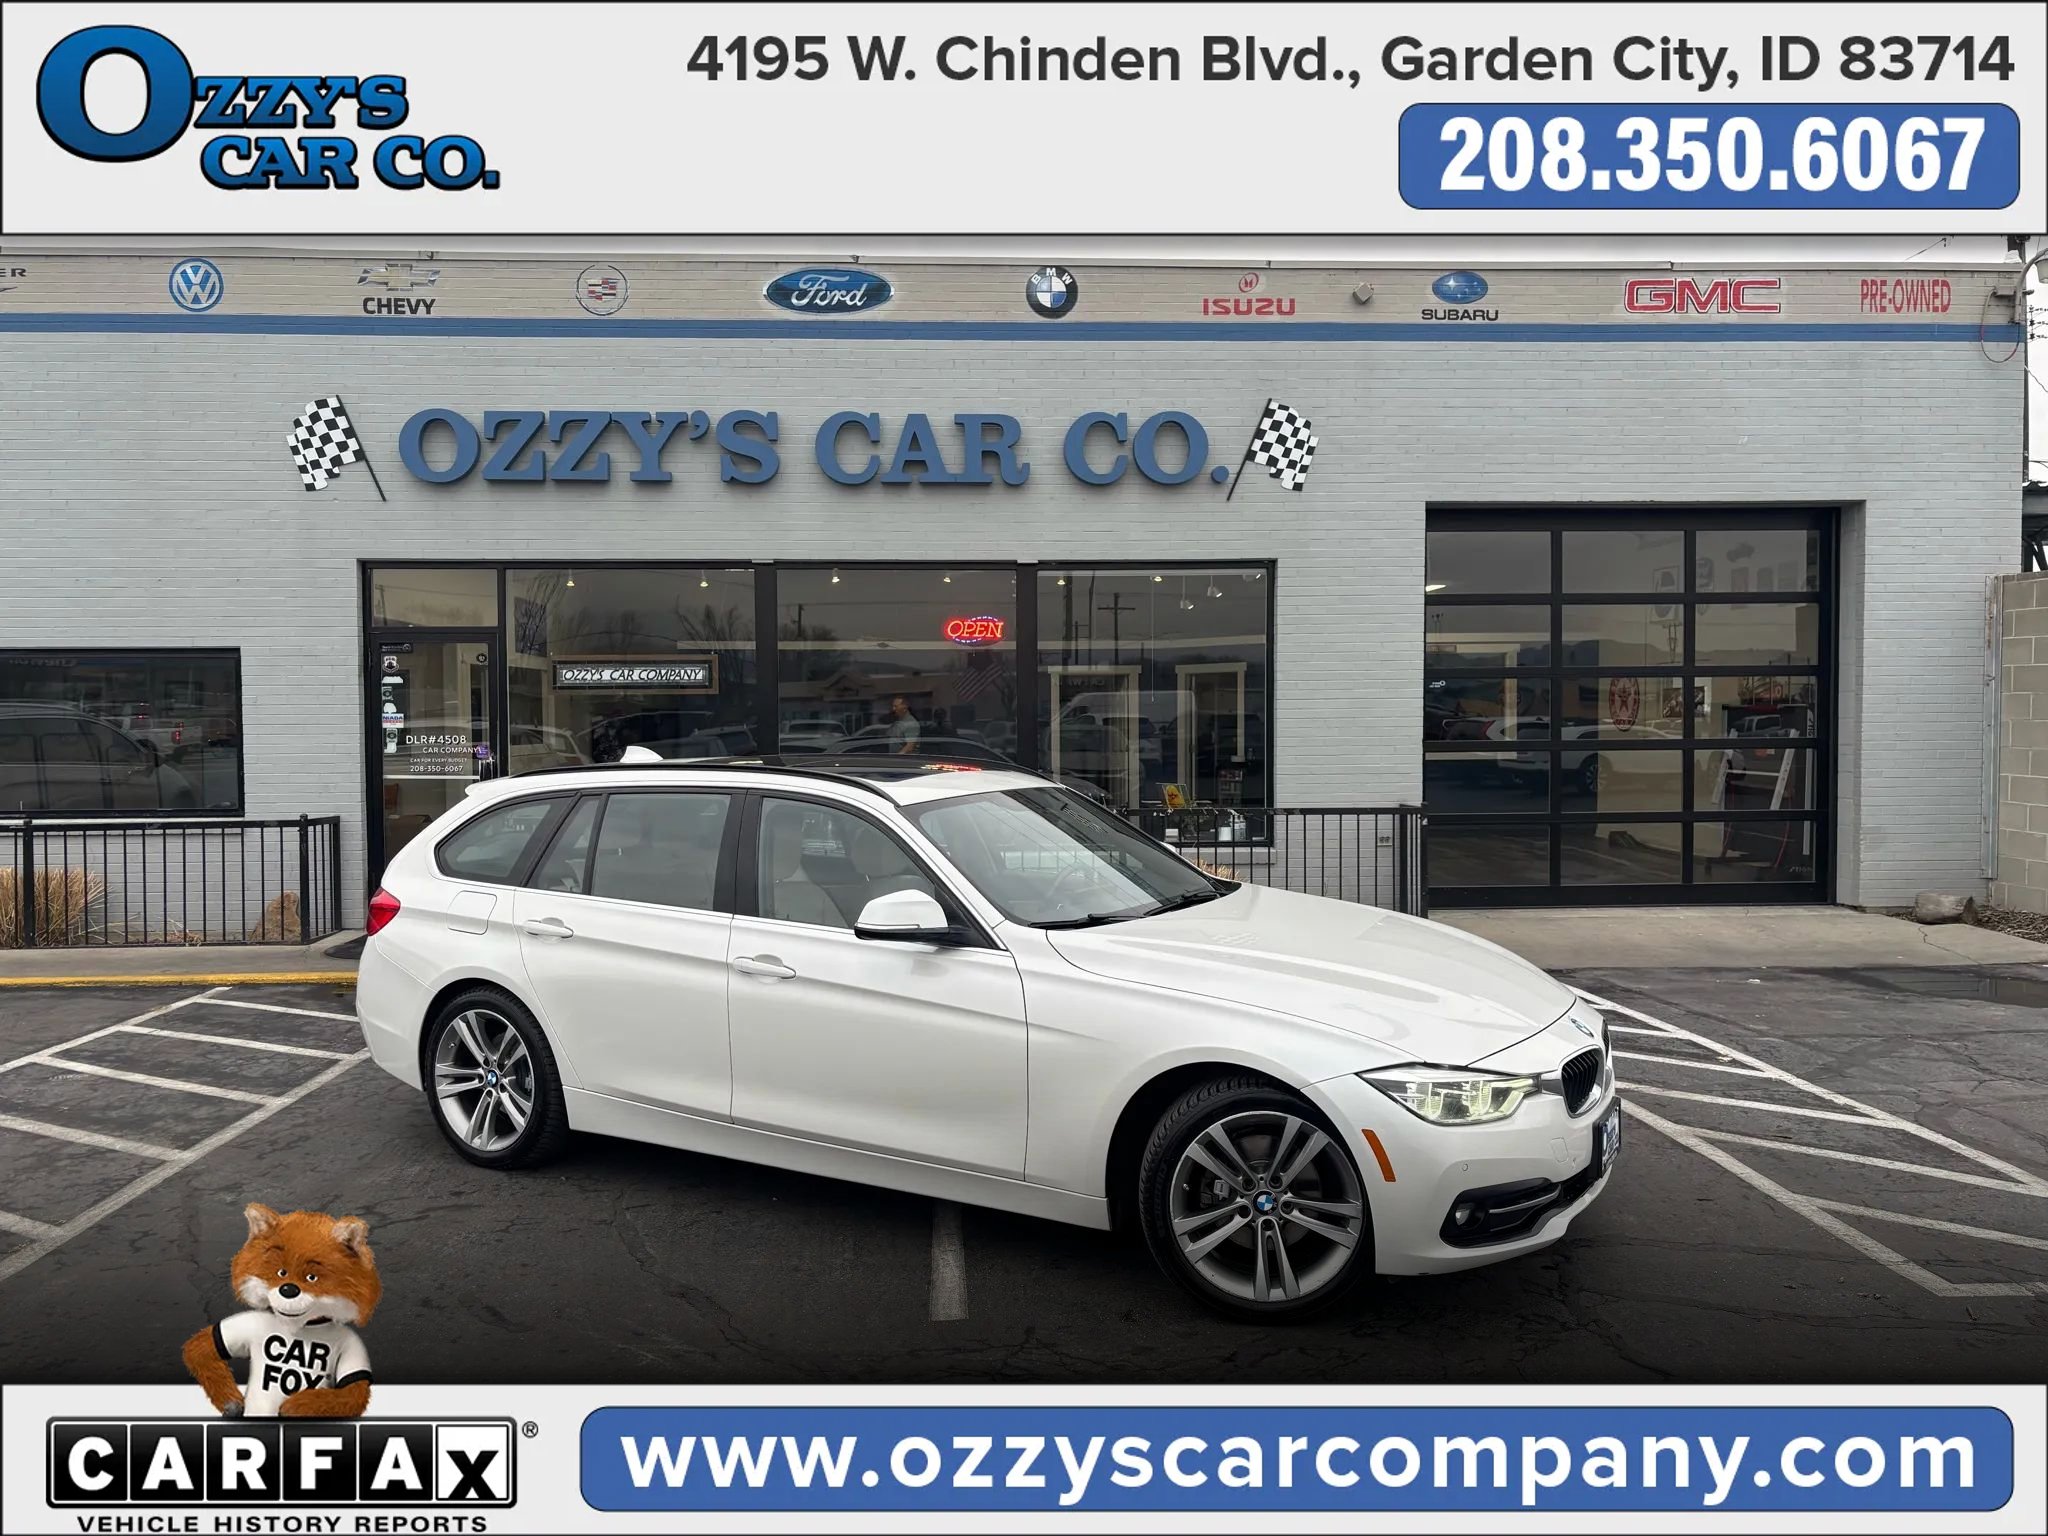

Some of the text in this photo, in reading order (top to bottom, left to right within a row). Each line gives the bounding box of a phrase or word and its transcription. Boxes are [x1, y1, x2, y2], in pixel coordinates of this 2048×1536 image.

[791, 274, 868, 307] Ford
[1624, 278, 1781, 313] GMC
[1860, 279, 1952, 314] PRE-OWNED
[363, 297, 436, 315] CHEVY
[1202, 298, 1296, 316] ISUZU
[1421, 309, 1499, 322] SUBARU
[399, 408, 1230, 486] OZZY'S CAR CO.
[947, 620, 1005, 638] OPEN
[610, 669, 635, 681] CAR
[638, 669, 701, 681] COMPANY
[405, 735, 468, 745] DLR#4508
[422, 746, 439, 754] CAR
[410, 765, 464, 773] 208-350-6067
